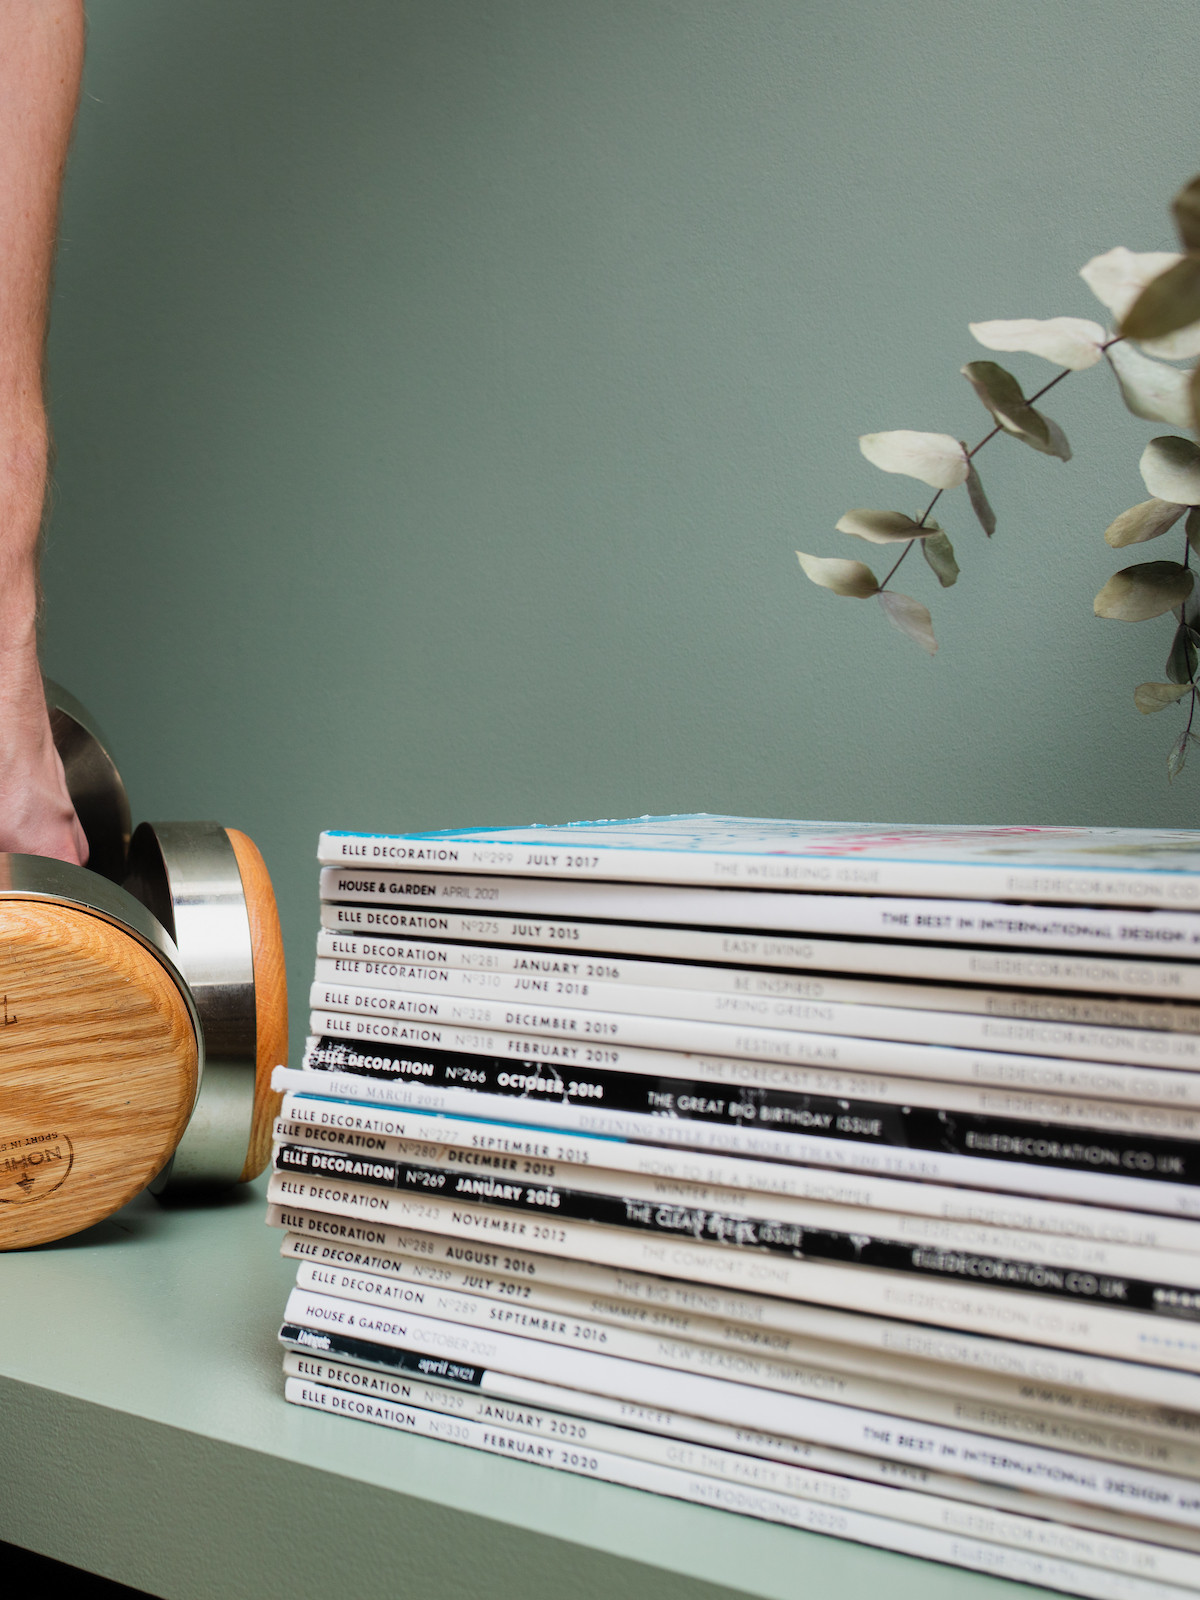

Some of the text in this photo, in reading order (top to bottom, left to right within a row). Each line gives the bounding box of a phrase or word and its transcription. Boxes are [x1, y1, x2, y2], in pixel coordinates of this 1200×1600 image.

[342, 845, 367, 856] ELLE
[373, 847, 459, 861] DECORATION
[526, 854, 558, 866] JULY
[567, 856, 599, 868] 2017
[338, 880, 376, 892] HOUSE
[378, 882, 386, 893] &
[389, 883, 436, 896] GARDEN
[338, 911, 361, 923] ELLE
[367, 913, 448, 930] DECORATION
[512, 924, 541, 937] JULY
[549, 927, 579, 940] 2015
[332, 942, 620, 979] ELLE DECORATION JANUARY 2016
[335, 960, 359, 972] ELLE
[366, 963, 448, 981] DECORATION
[515, 977, 549, 992] JUNE
[556, 982, 589, 996] 2018
[325, 992, 349, 1005] ELLE
[355, 996, 439, 1015] DECORATION
[506, 1012, 577, 1031] DECEMBER
[585, 1021, 618, 1035] 2019
[326, 1019, 351, 1032] ELLE
[357, 1022, 441, 1043] DECORATION
[508, 1040, 580, 1059] FEBRUARY
[586, 1049, 619, 1064] 2019
[347, 1054, 434, 1077] DECORATION
[497, 1072, 564, 1094] OCTOBER
[567, 1080, 604, 1099] 2014
[291, 1108, 589, 1164] ELLE DECORATION SEPTEMBER 2015
[647, 1091, 674, 1109] THE
[676, 1094, 725, 1116] GREAT
[759, 1105, 834, 1130] BIRTHDAY
[836, 1115, 881, 1136] ISSUE
[10, 1139, 23, 1150] IN
[24, 1131, 59, 1146] SPORT
[276, 1123, 301, 1137] ELLE
[305, 1127, 386, 1151] DECORATION
[447, 1149, 517, 1172] DECEMBER
[524, 1161, 556, 1177] 2015
[282, 1150, 307, 1167] ELLE
[311, 1154, 395, 1181] DECORATION
[455, 1178, 523, 1202] JANUARY
[526, 1189, 561, 1208] 2015
[281, 1182, 304, 1196] ELLE
[310, 1187, 390, 1211] DECORATION
[451, 1211, 526, 1235] NOVEMBER
[533, 1226, 566, 1242] 2012
[281, 1213, 304, 1229] ELLE
[308, 1218, 386, 1245] DECORATION
[445, 1245, 499, 1268] AUGUST
[504, 1257, 535, 1275] 2016
[293, 1242, 317, 1257] ELLE
[322, 1247, 402, 1273] DECORATION
[462, 1274, 493, 1291] JULY
[499, 1281, 531, 1298] 2012
[306, 1306, 344, 1323] HOUSE
[347, 1314, 354, 1326] &
[358, 1316, 407, 1337] GARDEN
[311, 1270, 336, 1286] ELLE
[341, 1276, 424, 1305] DECORATION
[489, 1308, 566, 1335] SEPTEMBER
[573, 1325, 607, 1343] 2016
[298, 1361, 323, 1377] ELLE
[328, 1368, 411, 1398] DECORATION
[477, 1403, 542, 1429] JANUARY
[549, 1419, 587, 1439] 2020
[302, 1389, 326, 1405] ELLE
[332, 1396, 415, 1426] DECORATION
[483, 1433, 553, 1460] FEBRUARY
[562, 1451, 598, 1471] 2020
